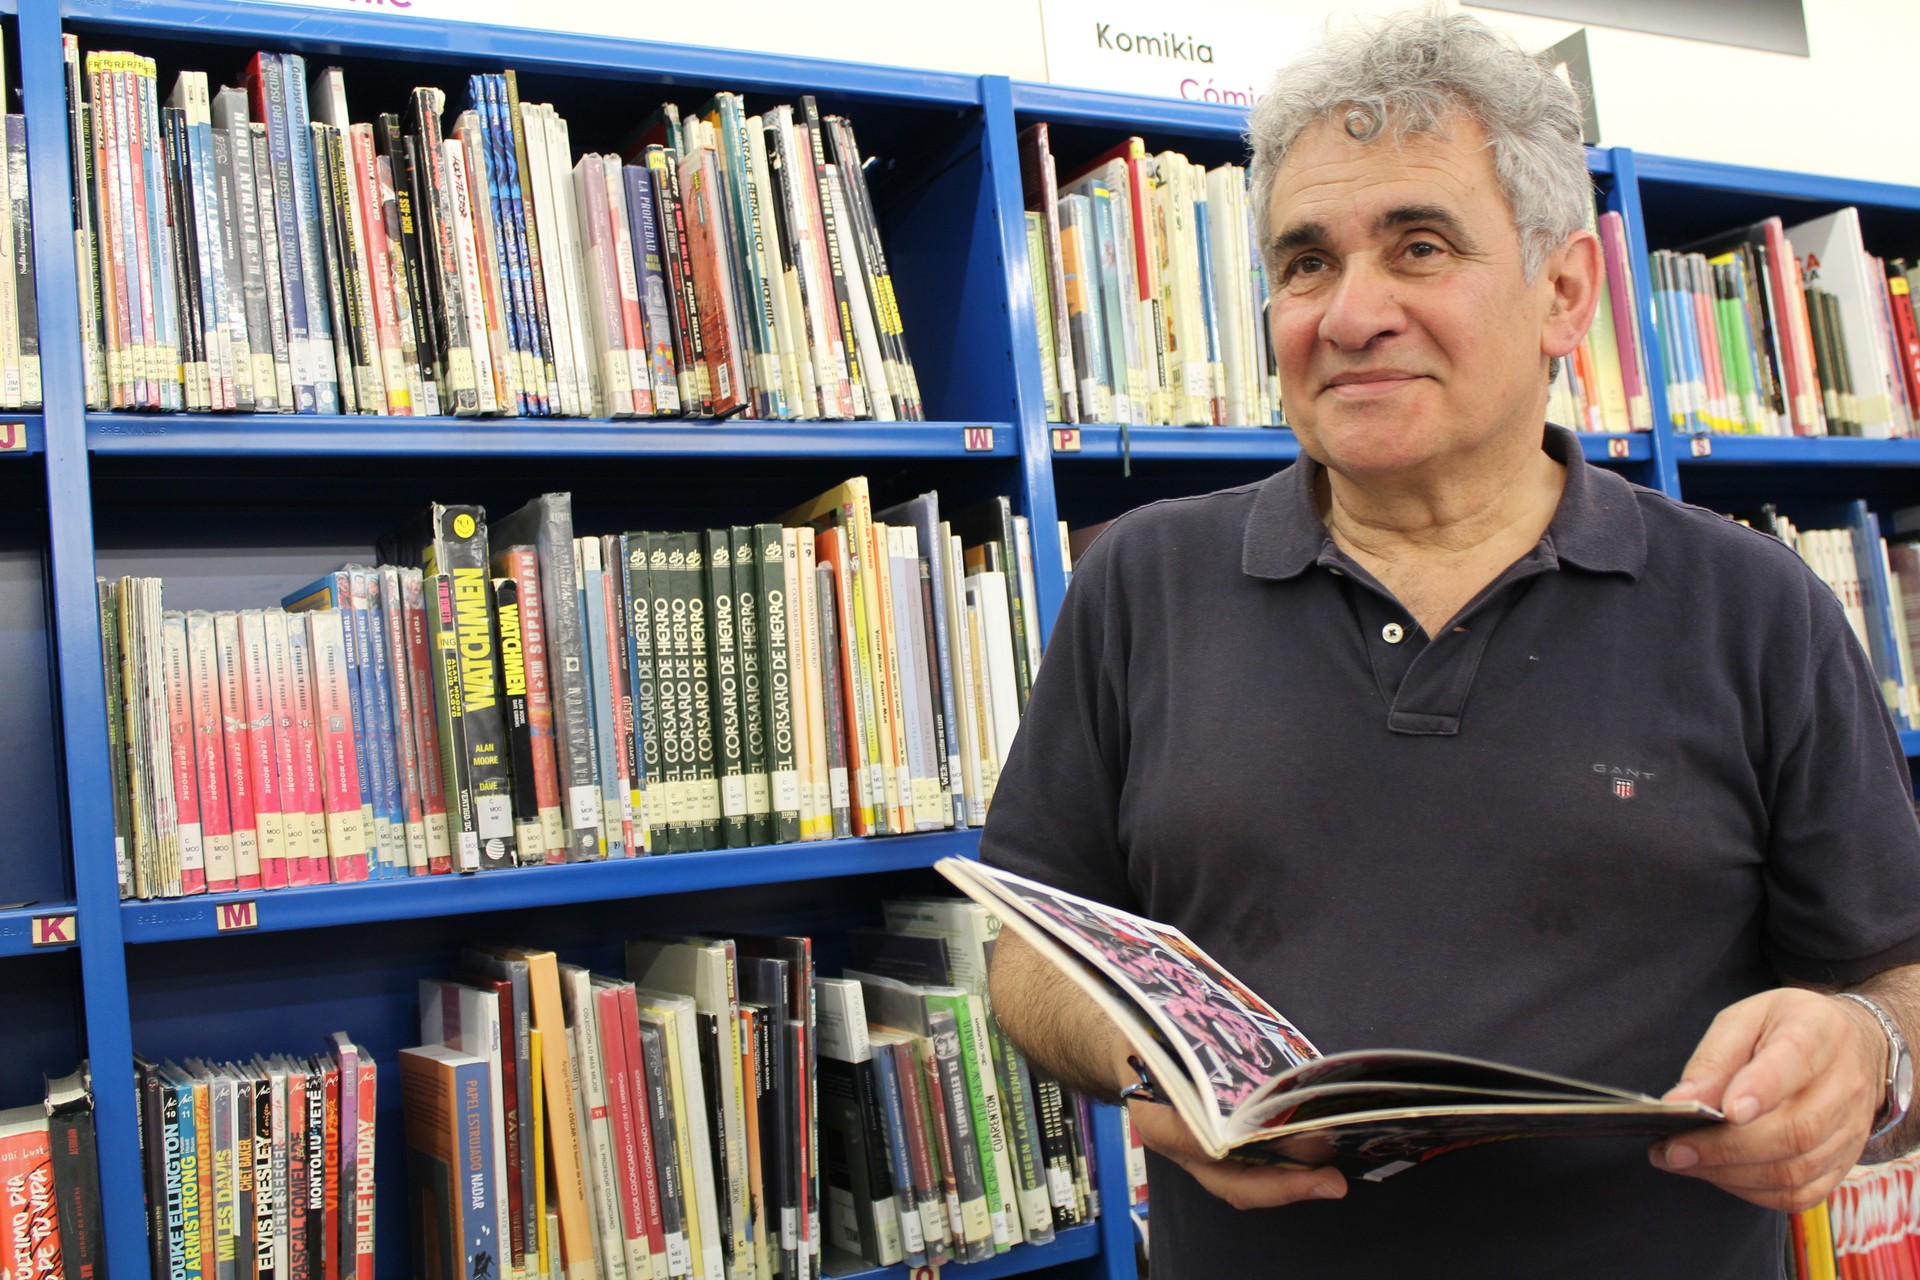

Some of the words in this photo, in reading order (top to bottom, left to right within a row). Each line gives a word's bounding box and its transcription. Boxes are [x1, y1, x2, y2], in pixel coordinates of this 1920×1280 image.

[1096, 22, 1214, 64] Komikia
[269, 62, 281, 103] OSCURO
[291, 66, 303, 104] OSCURO
[737, 107, 746, 120] EL
[233, 112, 249, 157] ROBIN
[272, 105, 287, 158] CABALLERO
[295, 105, 308, 158] CABALLERO
[811, 127, 826, 171] ASESINA
[278, 160, 288, 178] DEL
[300, 160, 310, 178] DEL
[363, 138, 375, 178] AUTORES
[739, 127, 754, 177] GARAJE
[240, 172, 256, 234] BATMAN
[280, 179, 293, 223] REGRESO
[370, 179, 381, 221] GRANDES
[638, 180, 649, 193] LA
[669, 177, 680, 197] CITY
[819, 177, 833, 216] BROMA
[285, 225, 294, 236] EL
[399, 199, 414, 234] KICK-ASS
[639, 196, 656, 251] PROPIEDAD
[826, 217, 836, 230] LA
[284, 238, 298, 281] BATMAN:
[379, 252, 391, 287] MILLER
[621, 240, 635, 294] metralla
[828, 233, 843, 277] BATMAN
[384, 290, 396, 326] FRANK
[686, 281, 697, 314] FRANK
[840, 301, 851, 331] BOLLAND
[691, 316, 703, 353] MILLER
[0, 424, 15, 449] J
[1060, 429, 1074, 450] P
[521, 556, 543, 654] SUPERMAN
[740, 592, 756, 650] HIERRO
[768, 589, 785, 647] HIERRO
[343, 615, 352, 632] TOM
[413, 616, 421, 633] TOP
[415, 635, 422, 645] 10
[453, 568, 497, 712] WATCHMEN
[633, 598, 651, 657] HIERRO
[654, 597, 672, 656] HIERRO
[671, 597, 689, 656] HIERRO
[688, 597, 706, 656] HIERRO
[716, 595, 733, 653] HIERRO
[345, 633, 354, 663] STRONG
[498, 603, 527, 696] WATCHMEN
[719, 655, 732, 675] DE
[744, 652, 757, 672] DE
[772, 650, 785, 670] DE
[446, 658, 454, 687] DAVID
[451, 658, 459, 683] ALAN
[531, 660, 544, 679] STAR
[638, 660, 651, 679] DE
[659, 659, 673, 679] DE
[676, 659, 689, 679] DE
[693, 659, 706, 678] DE
[449, 689, 457, 718] LLOYD
[454, 686, 462, 718] MOORE
[533, 691, 546, 704] ALL
[745, 674, 764, 755] CORSARIO
[772, 673, 792, 754] CORSARIO
[640, 681, 659, 764] CORSARIO
[660, 681, 679, 763] CORSARIO
[677, 681, 696, 763] CORSARIO
[694, 680, 713, 761] CORSARIO
[721, 677, 740, 759] CORSARIO
[208, 747, 216, 768] TERRY
[234, 743, 242, 766] TERRY
[260, 740, 269, 763] TERRY
[284, 739, 293, 762] TERRY
[304, 739, 314, 762] TERRY
[337, 740, 345, 764] TERRY
[473, 755, 499, 767] MOORE
[475, 743, 496, 755] ALAN
[779, 756, 792, 772] EL
[236, 766, 245, 797] MOORE
[261, 764, 271, 794] MOORE
[286, 762, 295, 792] MOORE
[306, 762, 315, 792] MOORE
[339, 766, 348, 794] MOORE
[646, 767, 660, 784] EL
[666, 766, 680, 782] EL
[683, 765, 697, 782] EL
[700, 764, 714, 781] EL
[727, 761, 741, 777] EL
[752, 759, 765, 775] EL
[1592, 764, 1656, 779] GANT
[181, 770, 189, 801] MOORE
[209, 769, 217, 801] MOORE
[461, 789, 474, 832] VERTIGO/DC
[41, 917, 68, 942] K
[223, 902, 251, 928] M
[947, 1059, 958, 1074] EL
[465, 1080, 479, 1112] PAPEL
[951, 1076, 969, 1138] ETERNAUTA
[237, 1139, 252, 1167] BAKER
[356, 1119, 374, 1196] HOLIDAY
[467, 1113, 483, 1171] ESTRUJADO
[599, 1143, 606, 1153] EL
[640, 1128, 653, 1179] COJONCIANO
[164, 1124, 184, 1226] ELLINGTON
[216, 1149, 233, 1203] DAVIS
[239, 1169, 253, 1192] CHET
[255, 1135, 272, 1216] PRESLEY
[272, 1143, 286, 1197] SEEGER
[289, 1132, 306, 1219] COMELADE
[309, 1135, 323, 1210] MONTOLIU
[601, 1153, 610, 1187] PROFESOR
[626, 1144, 640, 1197] COJONCIANO
[1020, 1143, 1036, 1190] GREEN
[5, 1172, 28, 1208] DÍA
[28, 1168, 50, 1213] VIDA
[470, 1173, 485, 1211] NADAR
[646, 1180, 658, 1216] PROFESOR
[181, 1156, 201, 1271] ARMSTRONG
[274, 1200, 287, 1237] PETE
[356, 1198, 374, 1255] BILLIE
[605, 1188, 616, 1230] COJONCIANO
[631, 1197, 643, 1234] PROFESOR
[651, 1216, 659, 1225] EL
[31, 1217, 52, 1243] TU
[216, 1205, 235, 1262] MILES
[257, 1219, 274, 1271] ELVIS
[36, 1243, 56, 1271] DE
[168, 1229, 187, 1280] DUKE
[291, 1221, 308, 1280] PASCAL
